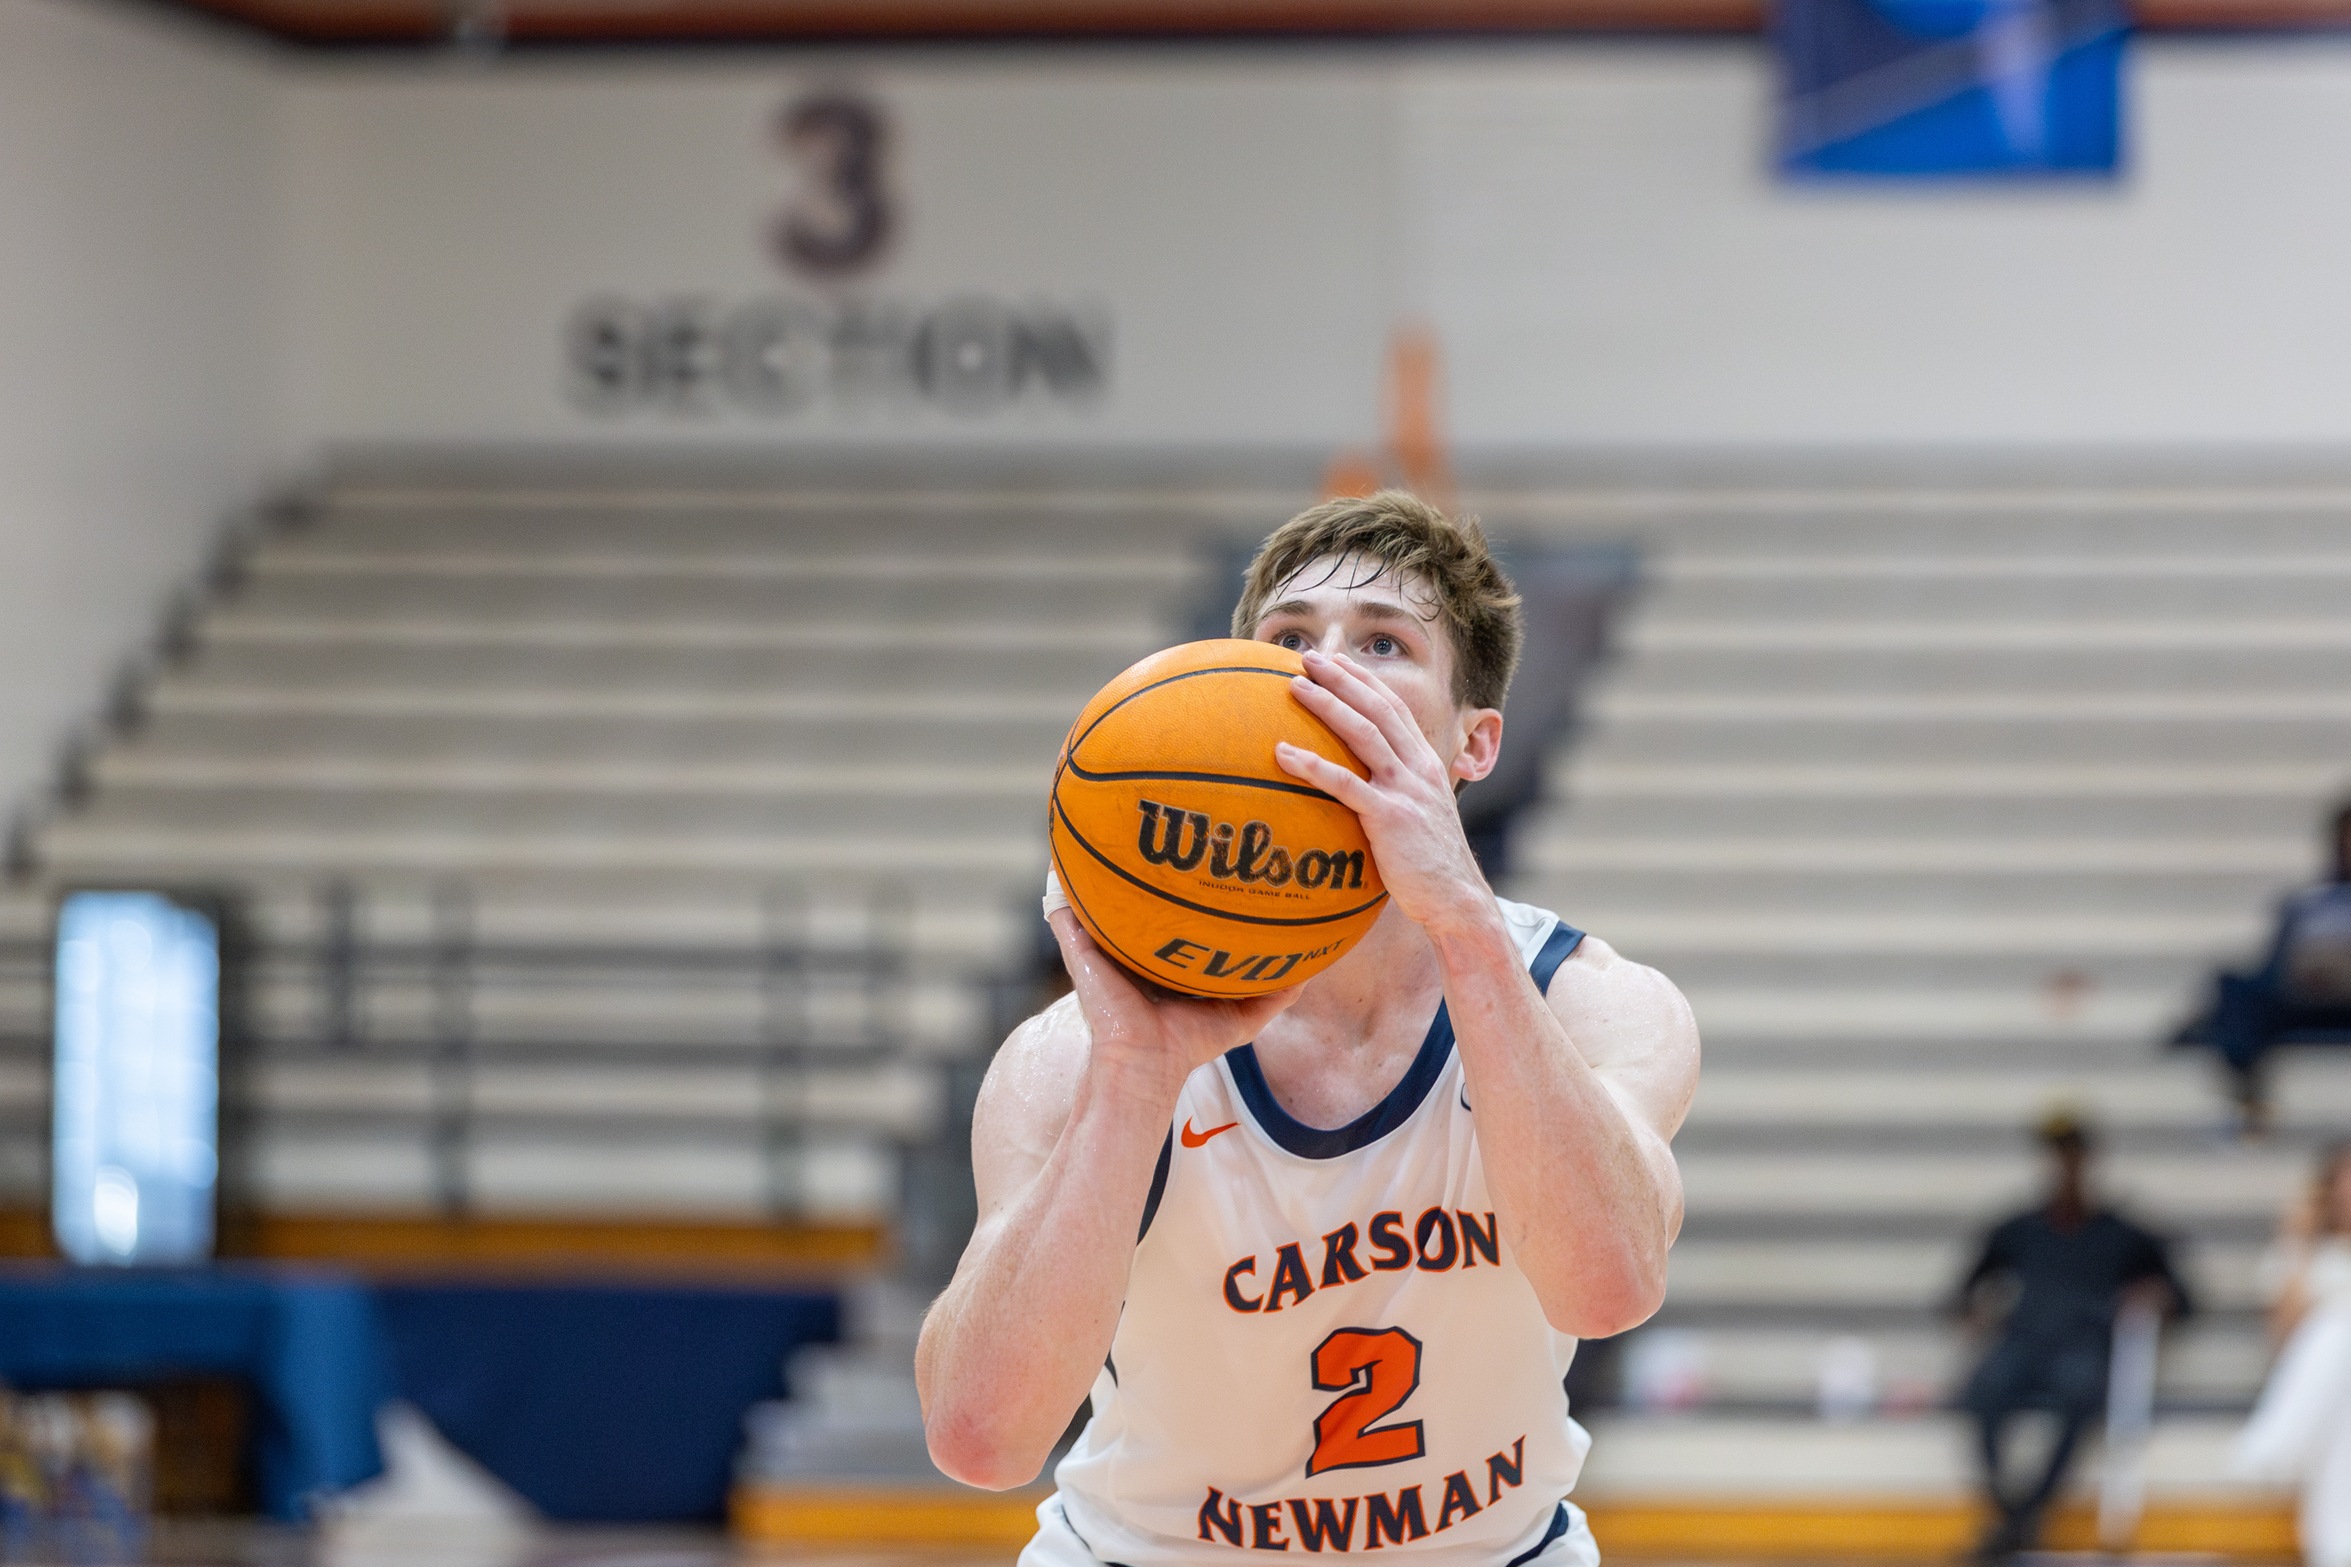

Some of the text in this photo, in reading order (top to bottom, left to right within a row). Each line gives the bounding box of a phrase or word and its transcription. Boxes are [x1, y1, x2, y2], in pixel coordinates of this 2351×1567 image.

[767, 92, 897, 278] 3
[570, 300, 1108, 414] SECTION
[1137, 799, 1365, 890] Wilson
[1248, 889, 1281, 898] GAME
[1284, 892, 1310, 900] BALL
[1153, 937, 1348, 982] EVO NXT
[1222, 1206, 1501, 1313] CARSON
[1305, 1325, 1427, 1479] 2
[1197, 1434, 1527, 1553] NEWMAN
